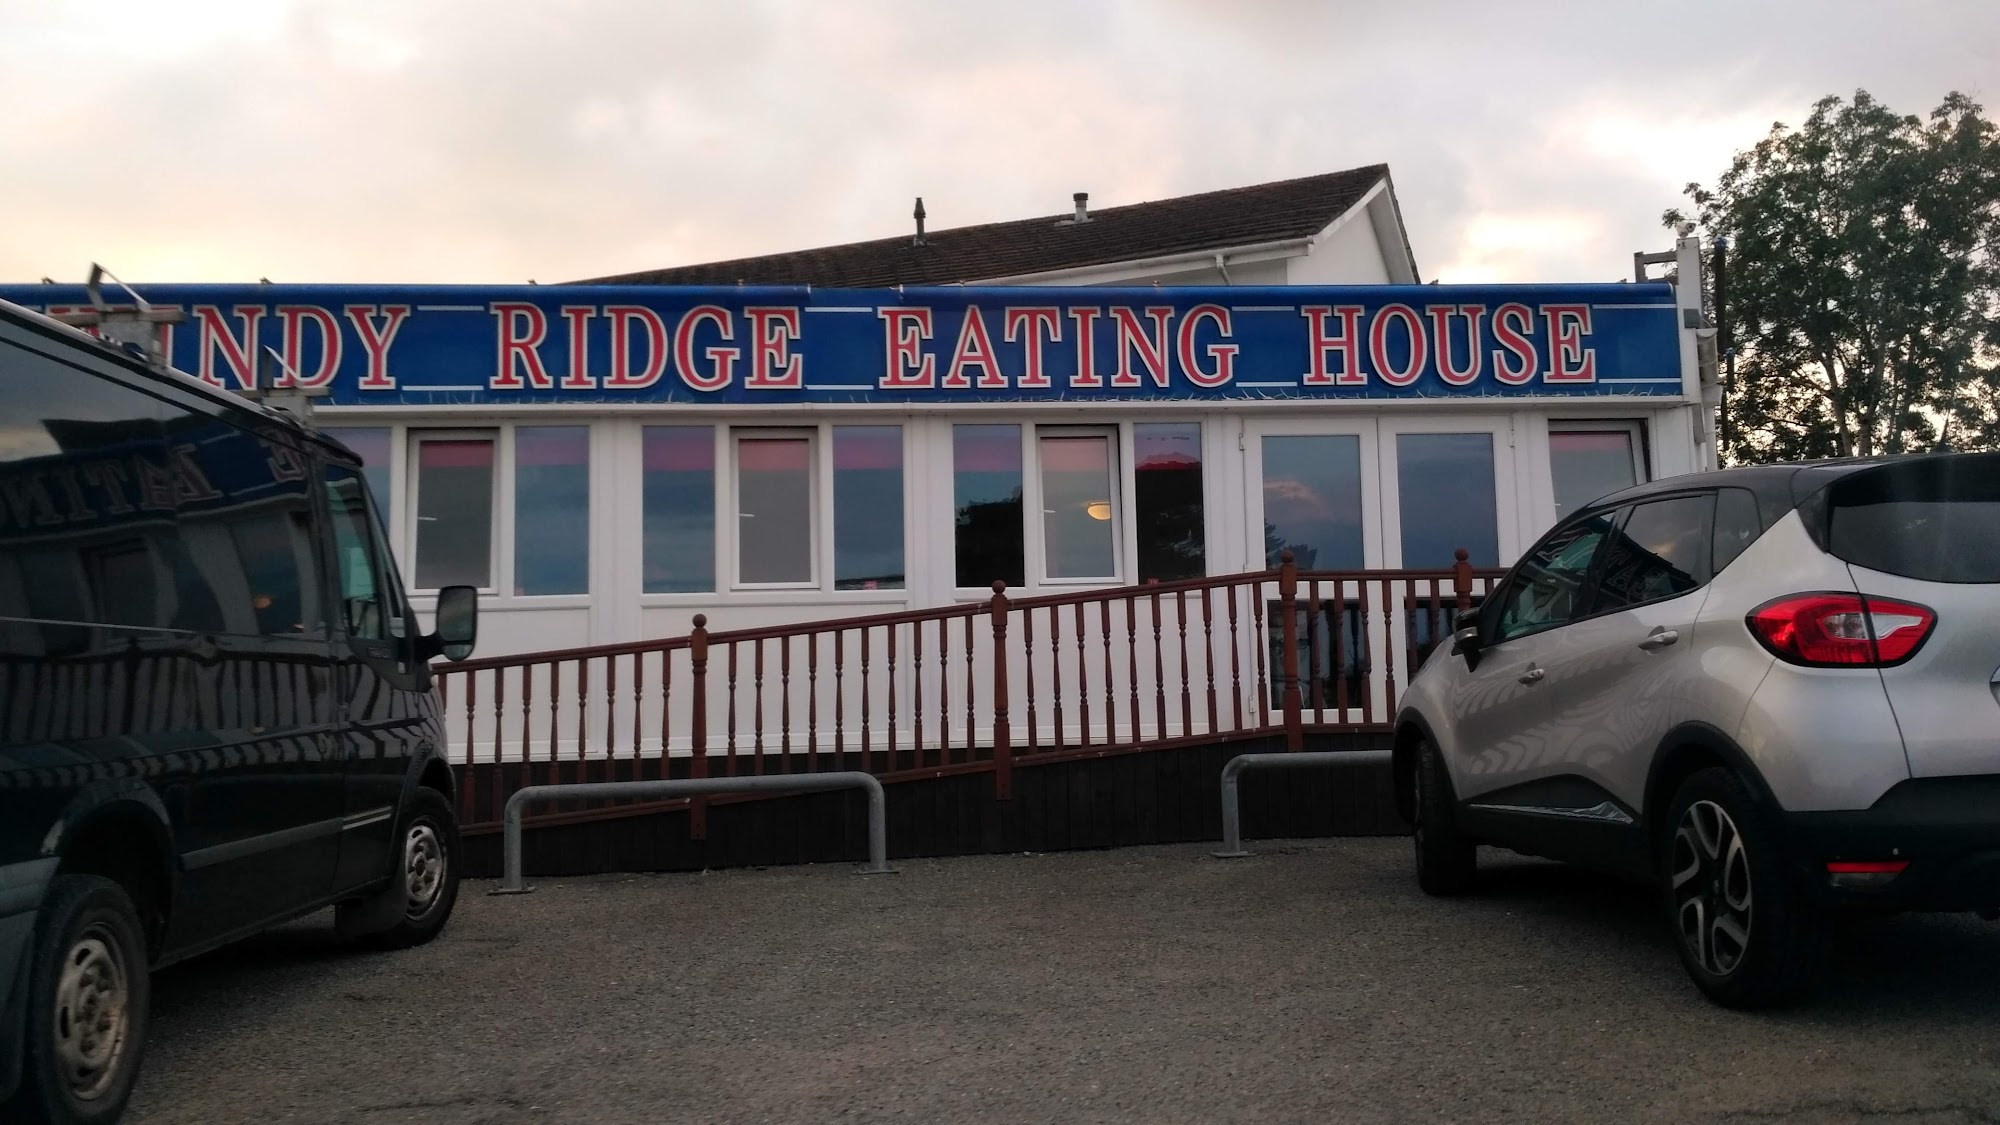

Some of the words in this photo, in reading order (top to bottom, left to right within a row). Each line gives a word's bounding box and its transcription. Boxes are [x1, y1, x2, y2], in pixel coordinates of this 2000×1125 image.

[45, 304, 412, 391] NDY
[488, 302, 803, 392] RIDGE
[877, 303, 1240, 391] EATING
[1301, 301, 1597, 387] HOUSE
